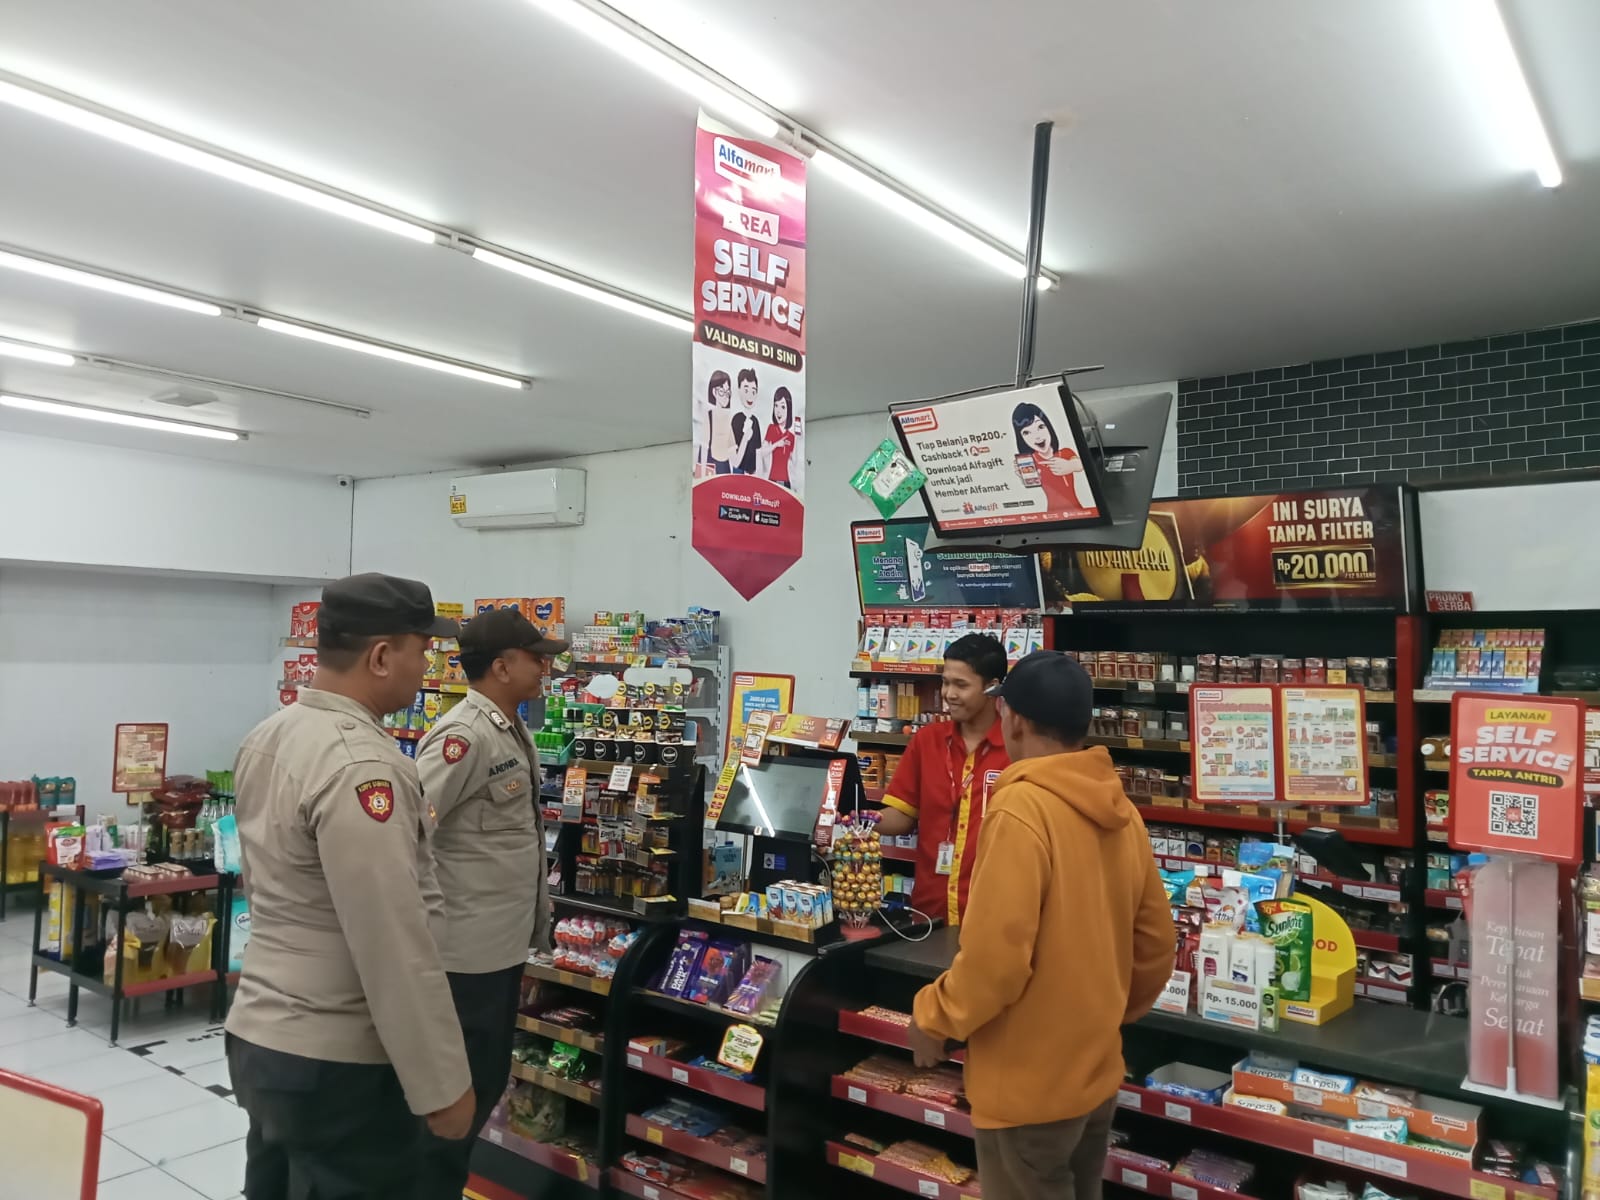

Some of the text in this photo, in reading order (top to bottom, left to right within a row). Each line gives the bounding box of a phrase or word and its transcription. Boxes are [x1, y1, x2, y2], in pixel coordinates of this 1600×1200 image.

[718, 144, 777, 177] Alfamart
[713, 238, 789, 287] SELF
[701, 279, 805, 332] SERVICE
[704, 325, 797, 367] VALIDASI DI SINI
[900, 413, 932, 425] Alfamart
[916, 430, 1008, 452] Tiap Belanja Rp200,-
[921, 450, 963, 462] Cashback
[926, 458, 1004, 476] Download Alfagift
[930, 474, 973, 487] untuk jadi
[721, 491, 752, 503] DOWNLOAD
[934, 482, 1010, 499] Member Alfamart
[727, 511, 742, 521] Google
[1272, 496, 1365, 523] INI SURYA
[1267, 520, 1375, 544] TANPA FILTER
[1084, 548, 1170, 571] NUSANTARA
[1277, 551, 1368, 580] Rp 20.000
[1428, 591, 1465, 602] PROMO
[1437, 601, 1472, 612] SERBA
[1489, 710, 1547, 722] LAYANAN
[1476, 725, 1557, 746] SELF
[1457, 745, 1575, 772] SERVICE
[1472, 768, 1513, 779] TANPA
[1265, 914, 1303, 938] Sunlight
[1486, 920, 1545, 940] Keptusan
[1311, 938, 1338, 952] OD
[1206, 992, 1258, 1010] Rp. 15.000
